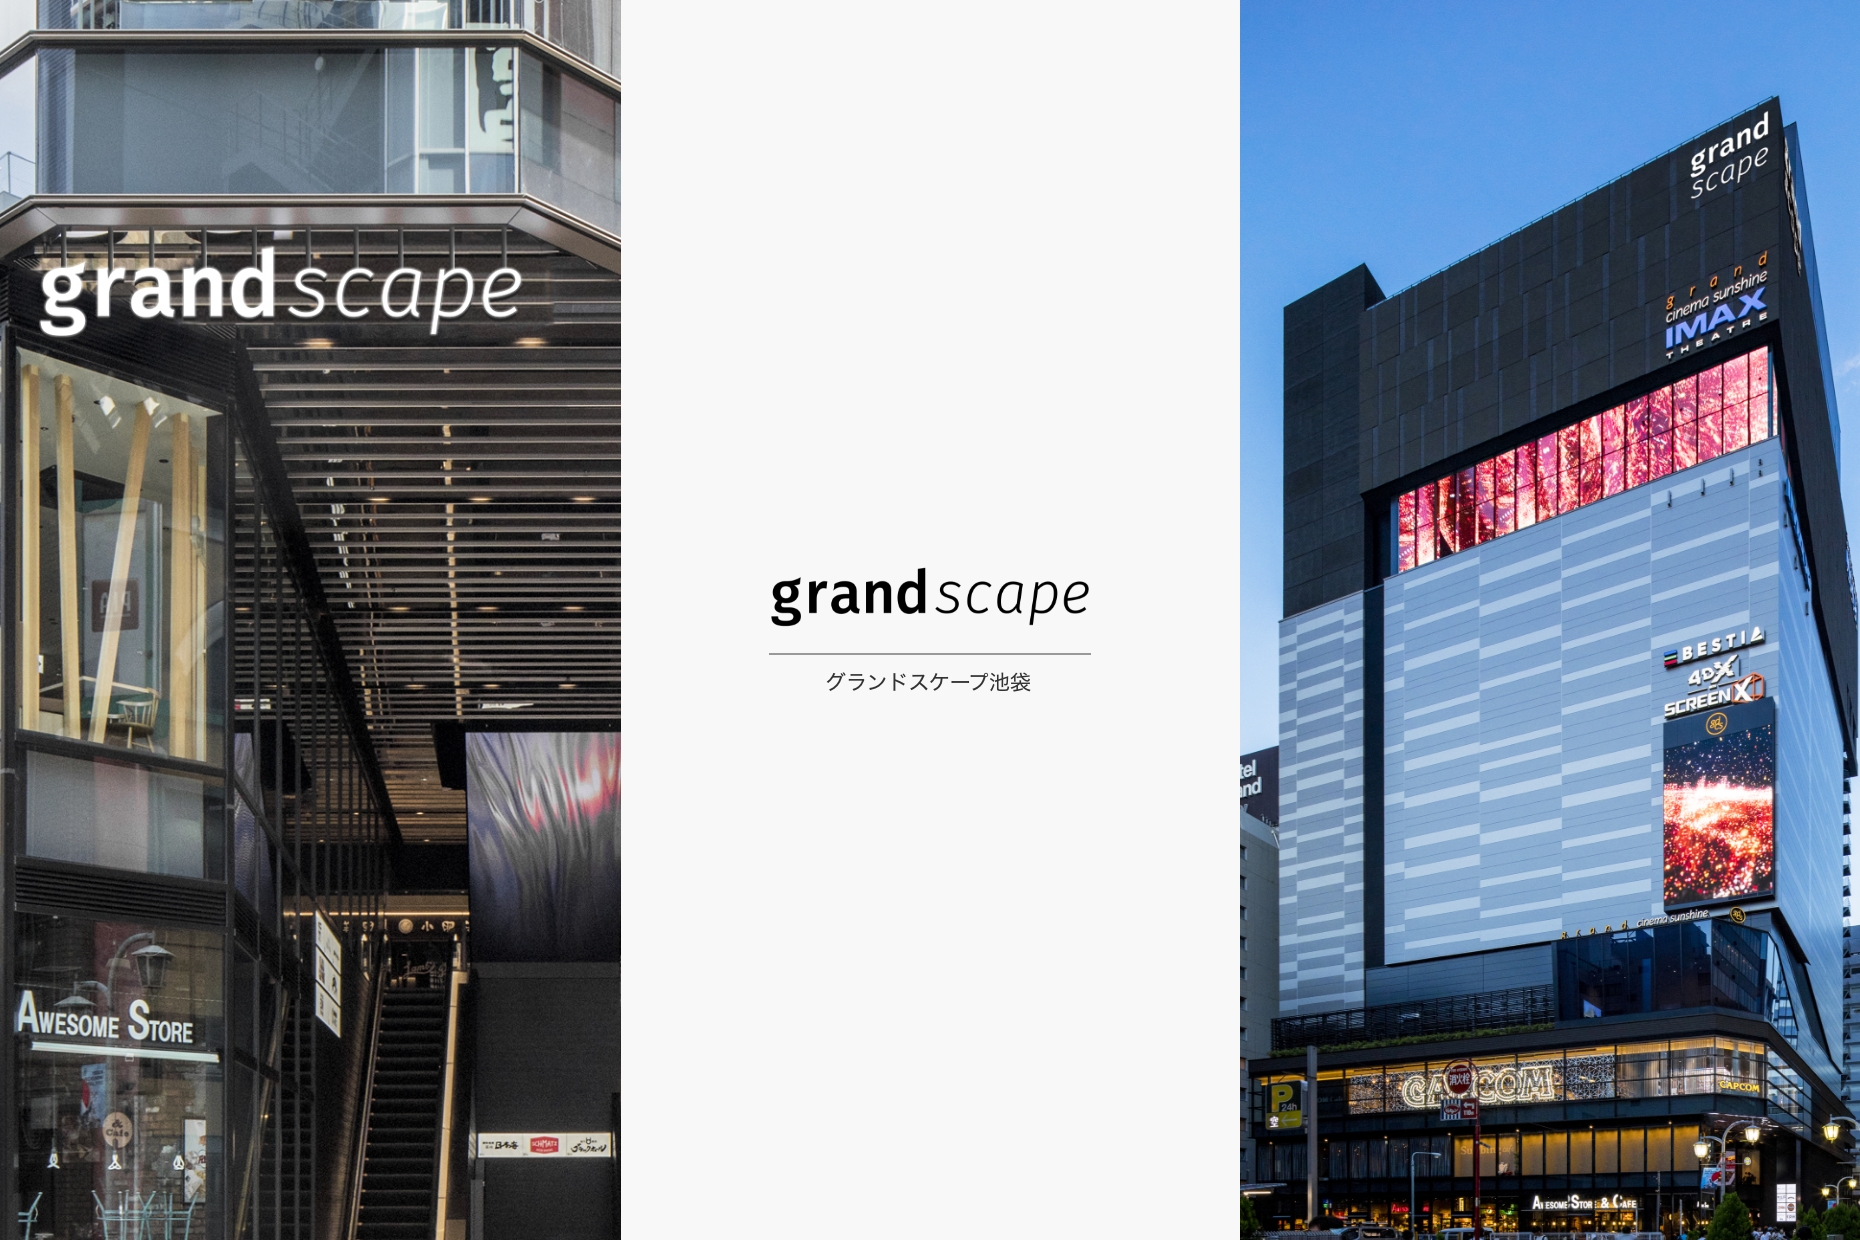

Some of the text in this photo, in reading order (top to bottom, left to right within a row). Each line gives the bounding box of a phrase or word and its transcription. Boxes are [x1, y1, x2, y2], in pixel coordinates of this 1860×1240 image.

[1690, 111, 1769, 178] grand
[1690, 146, 1769, 199] scape
[1665, 269, 1768, 323] cinema sunshine
[1666, 250, 1768, 310] grand
[1665, 286, 1767, 349] IMAX
[1665, 311, 1768, 360] THEATRE
[1682, 626, 1764, 661] BESTIA
[1688, 654, 1738, 686] 4DX
[1636, 914, 1668, 928] cinema
[1670, 909, 1709, 923] sunshine
[1402, 1065, 1554, 1107] CACOM
[1449, 1073, 1471, 1086] 消火栓
[1719, 1080, 1760, 1093] CAPCOM
[1271, 1084, 1293, 1112] P
[1281, 1103, 1297, 1112] 24h
[1601, 1197, 1609, 1209] &
